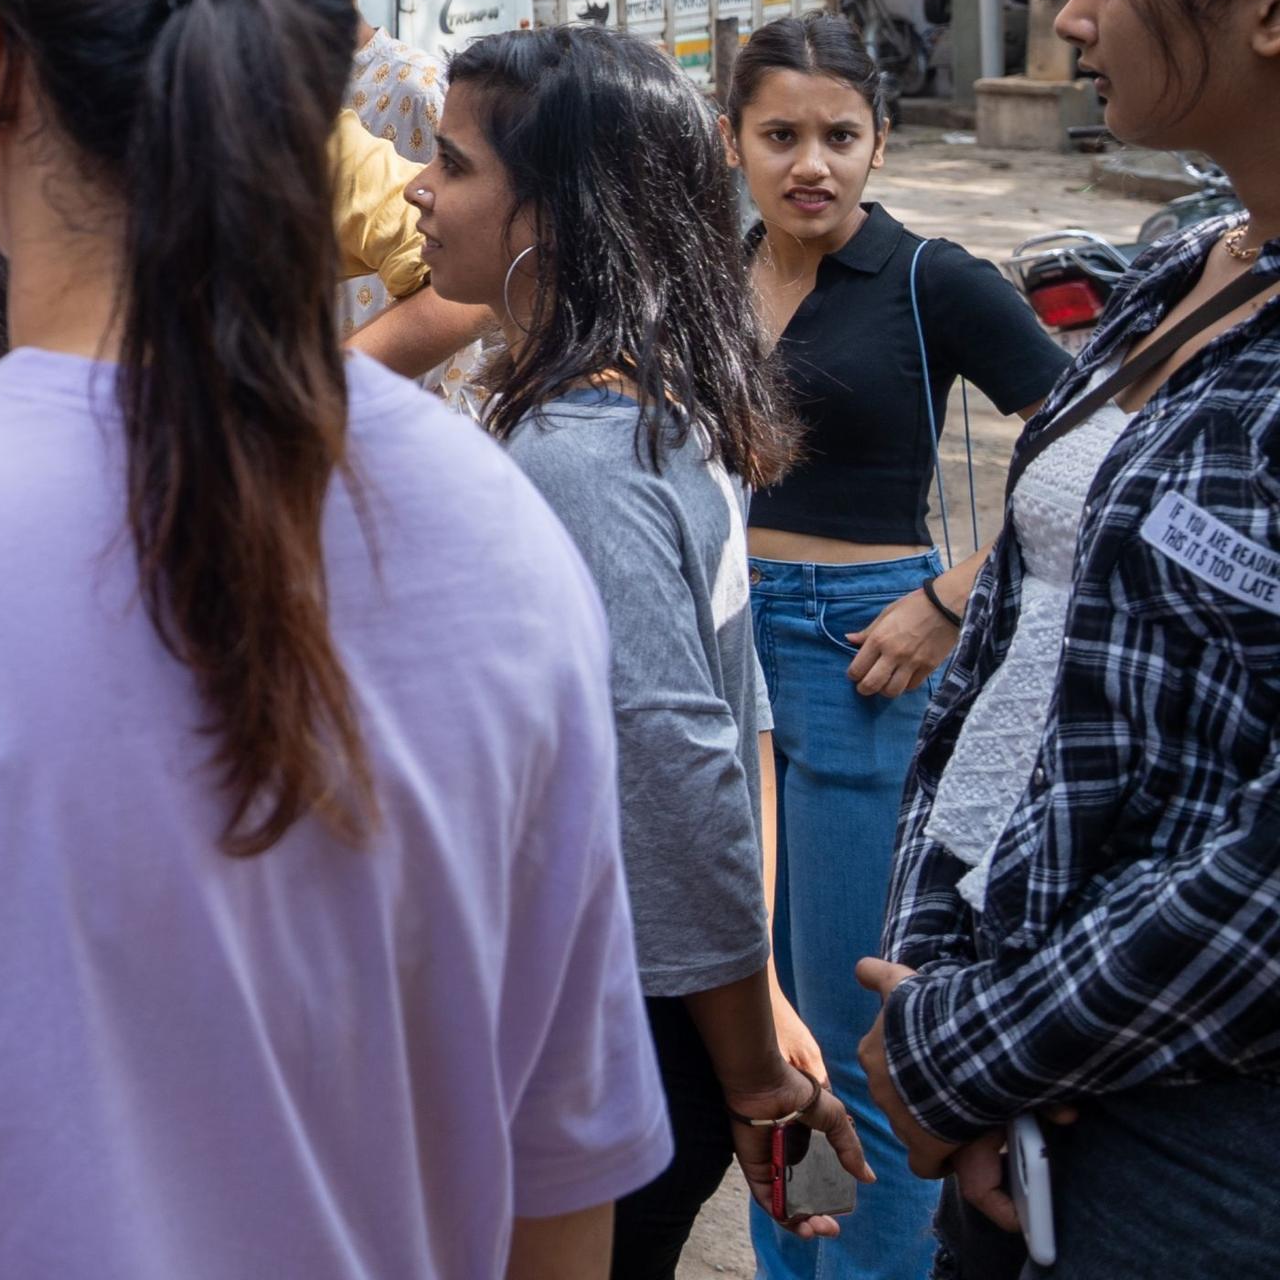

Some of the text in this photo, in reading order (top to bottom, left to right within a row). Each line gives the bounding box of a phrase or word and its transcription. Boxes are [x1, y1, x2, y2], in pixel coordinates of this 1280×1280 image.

[1161, 524, 1189, 552] THIS
[1208, 555, 1235, 583] TOO
[1238, 573, 1278, 602] LATE
[1169, 502, 1280, 582] IF YOU ARE READIN
